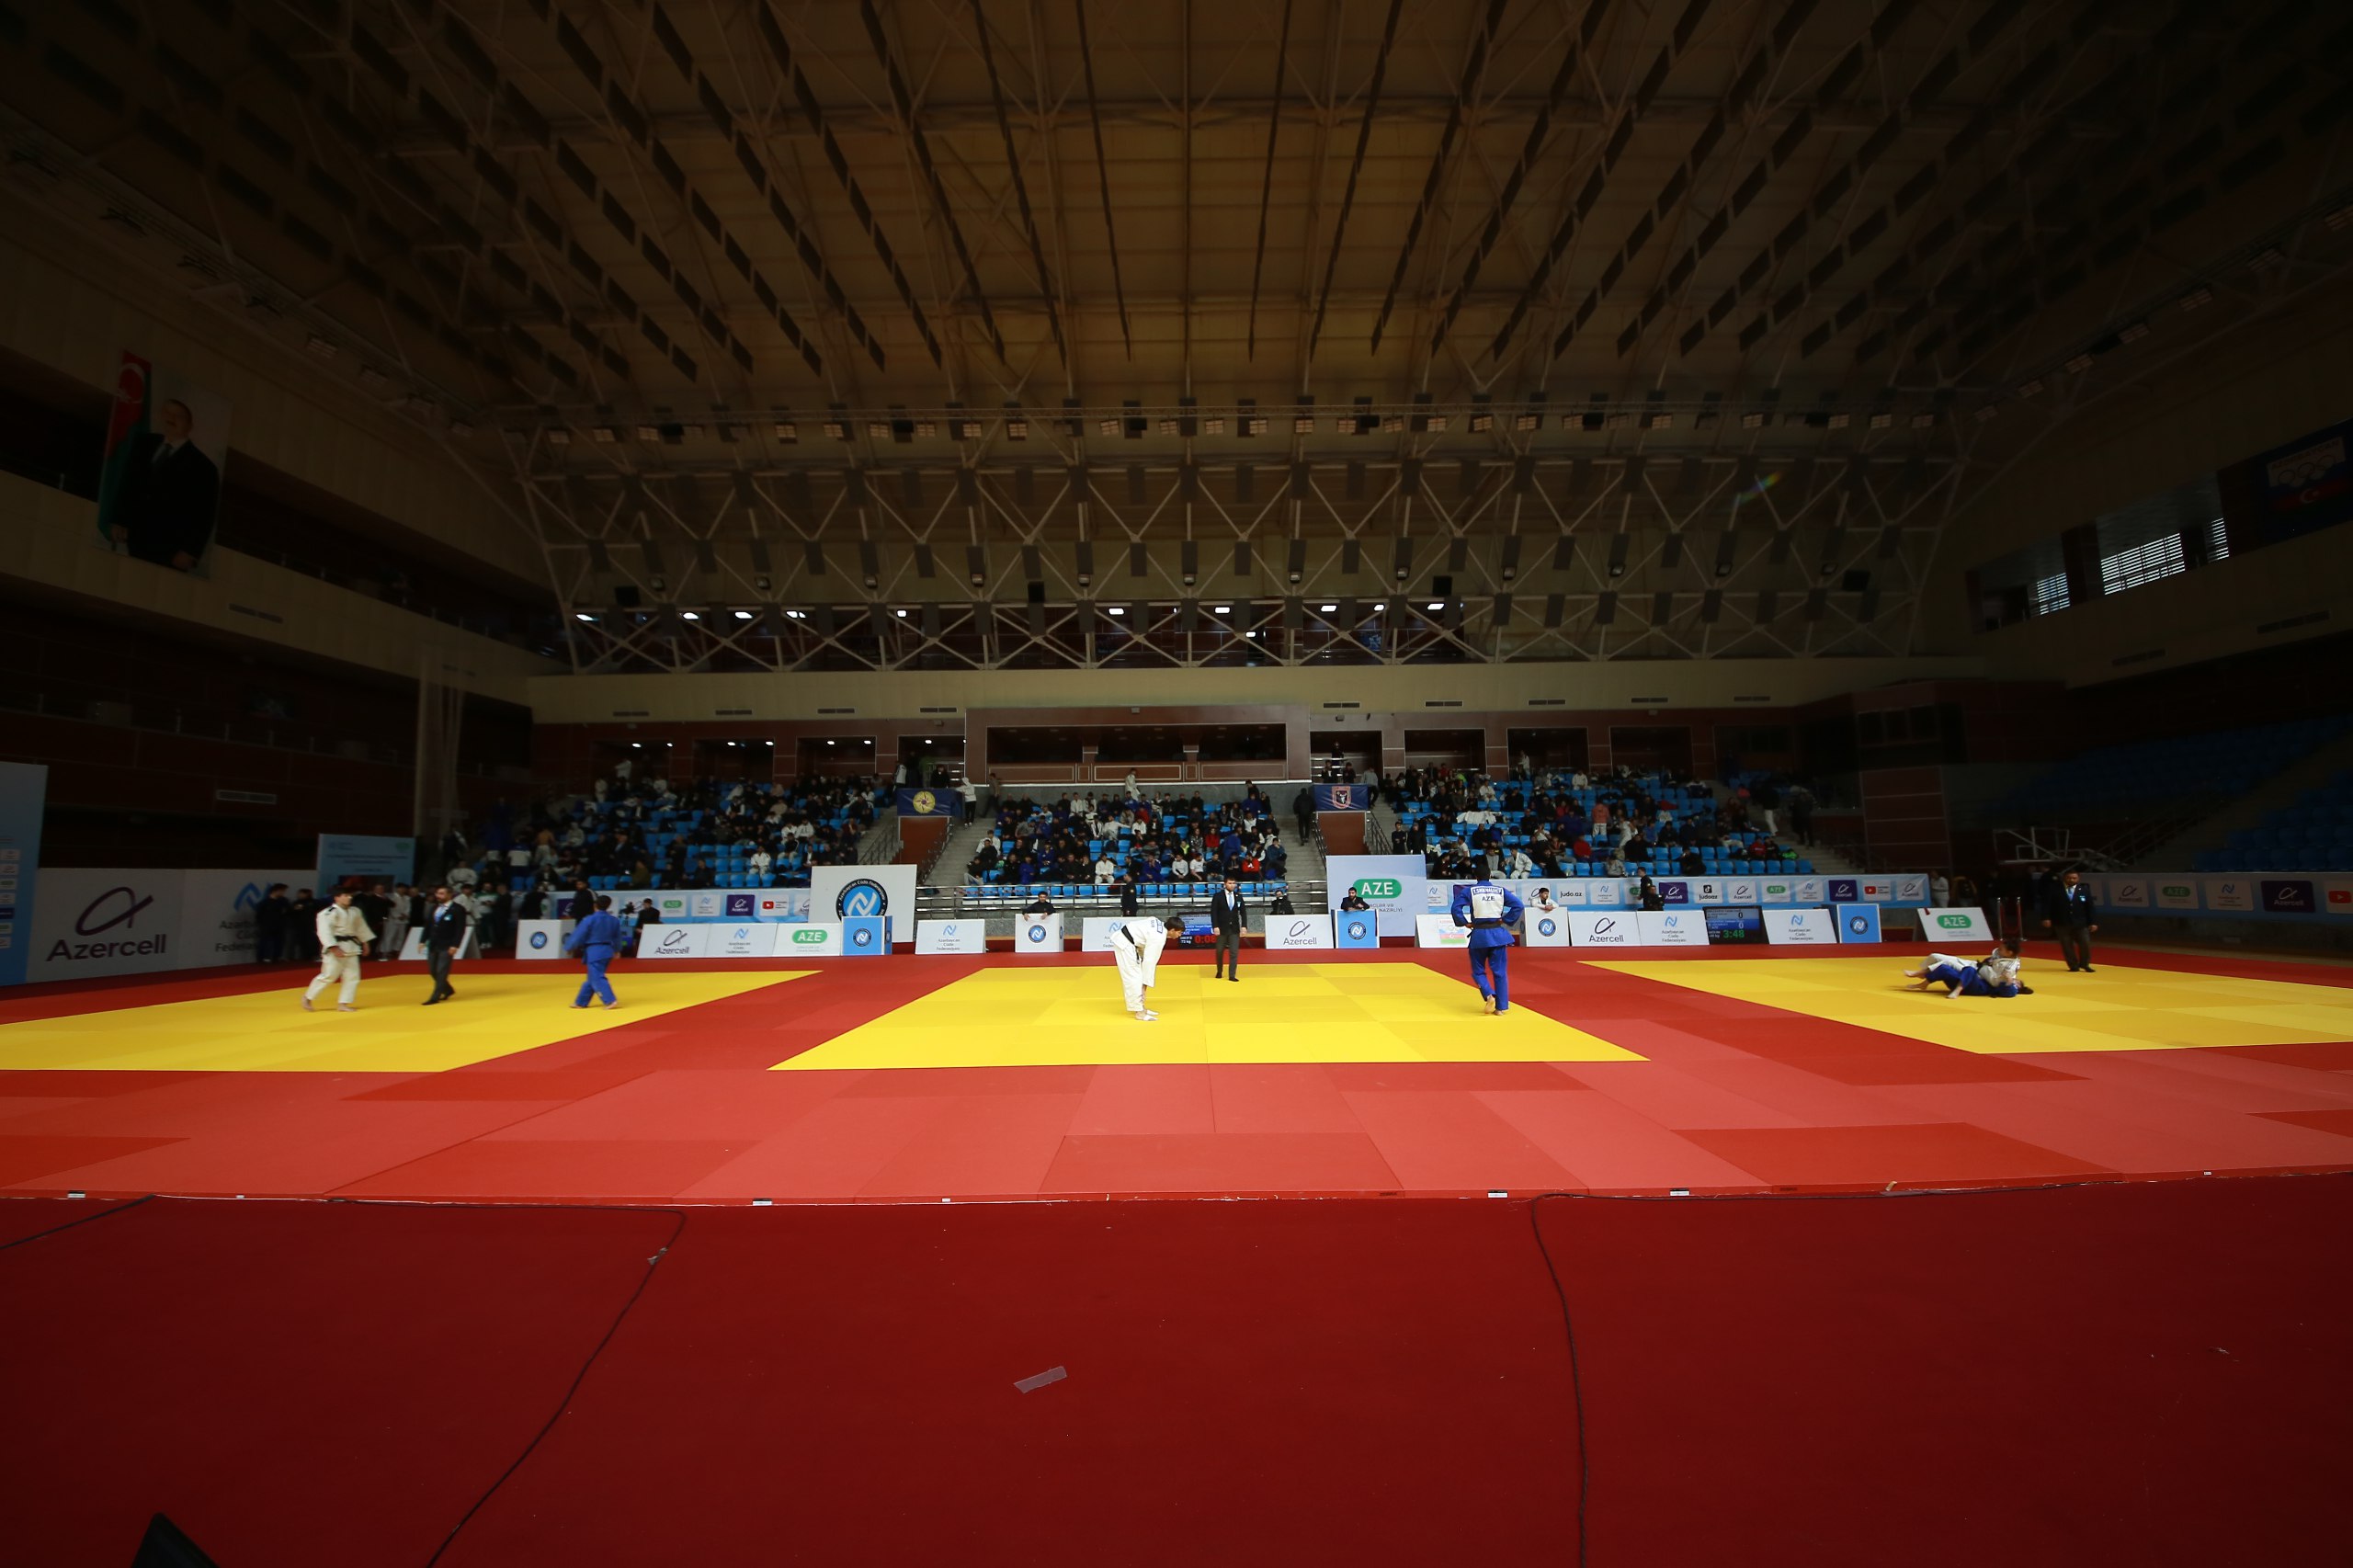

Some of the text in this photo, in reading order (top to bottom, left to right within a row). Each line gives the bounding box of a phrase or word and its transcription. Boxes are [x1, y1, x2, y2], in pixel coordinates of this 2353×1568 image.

[1361, 881, 1393, 895] AZE
[1738, 911, 1744, 919] 0
[1943, 916, 1967, 926] AZE
[797, 931, 823, 942] AZE
[1722, 929, 1745, 938] 3:48
[1283, 937, 1317, 946] Azercell
[1588, 934, 1624, 943] Azercell
[46, 933, 167, 962] Azercell
[654, 947, 690, 955] Azercell
